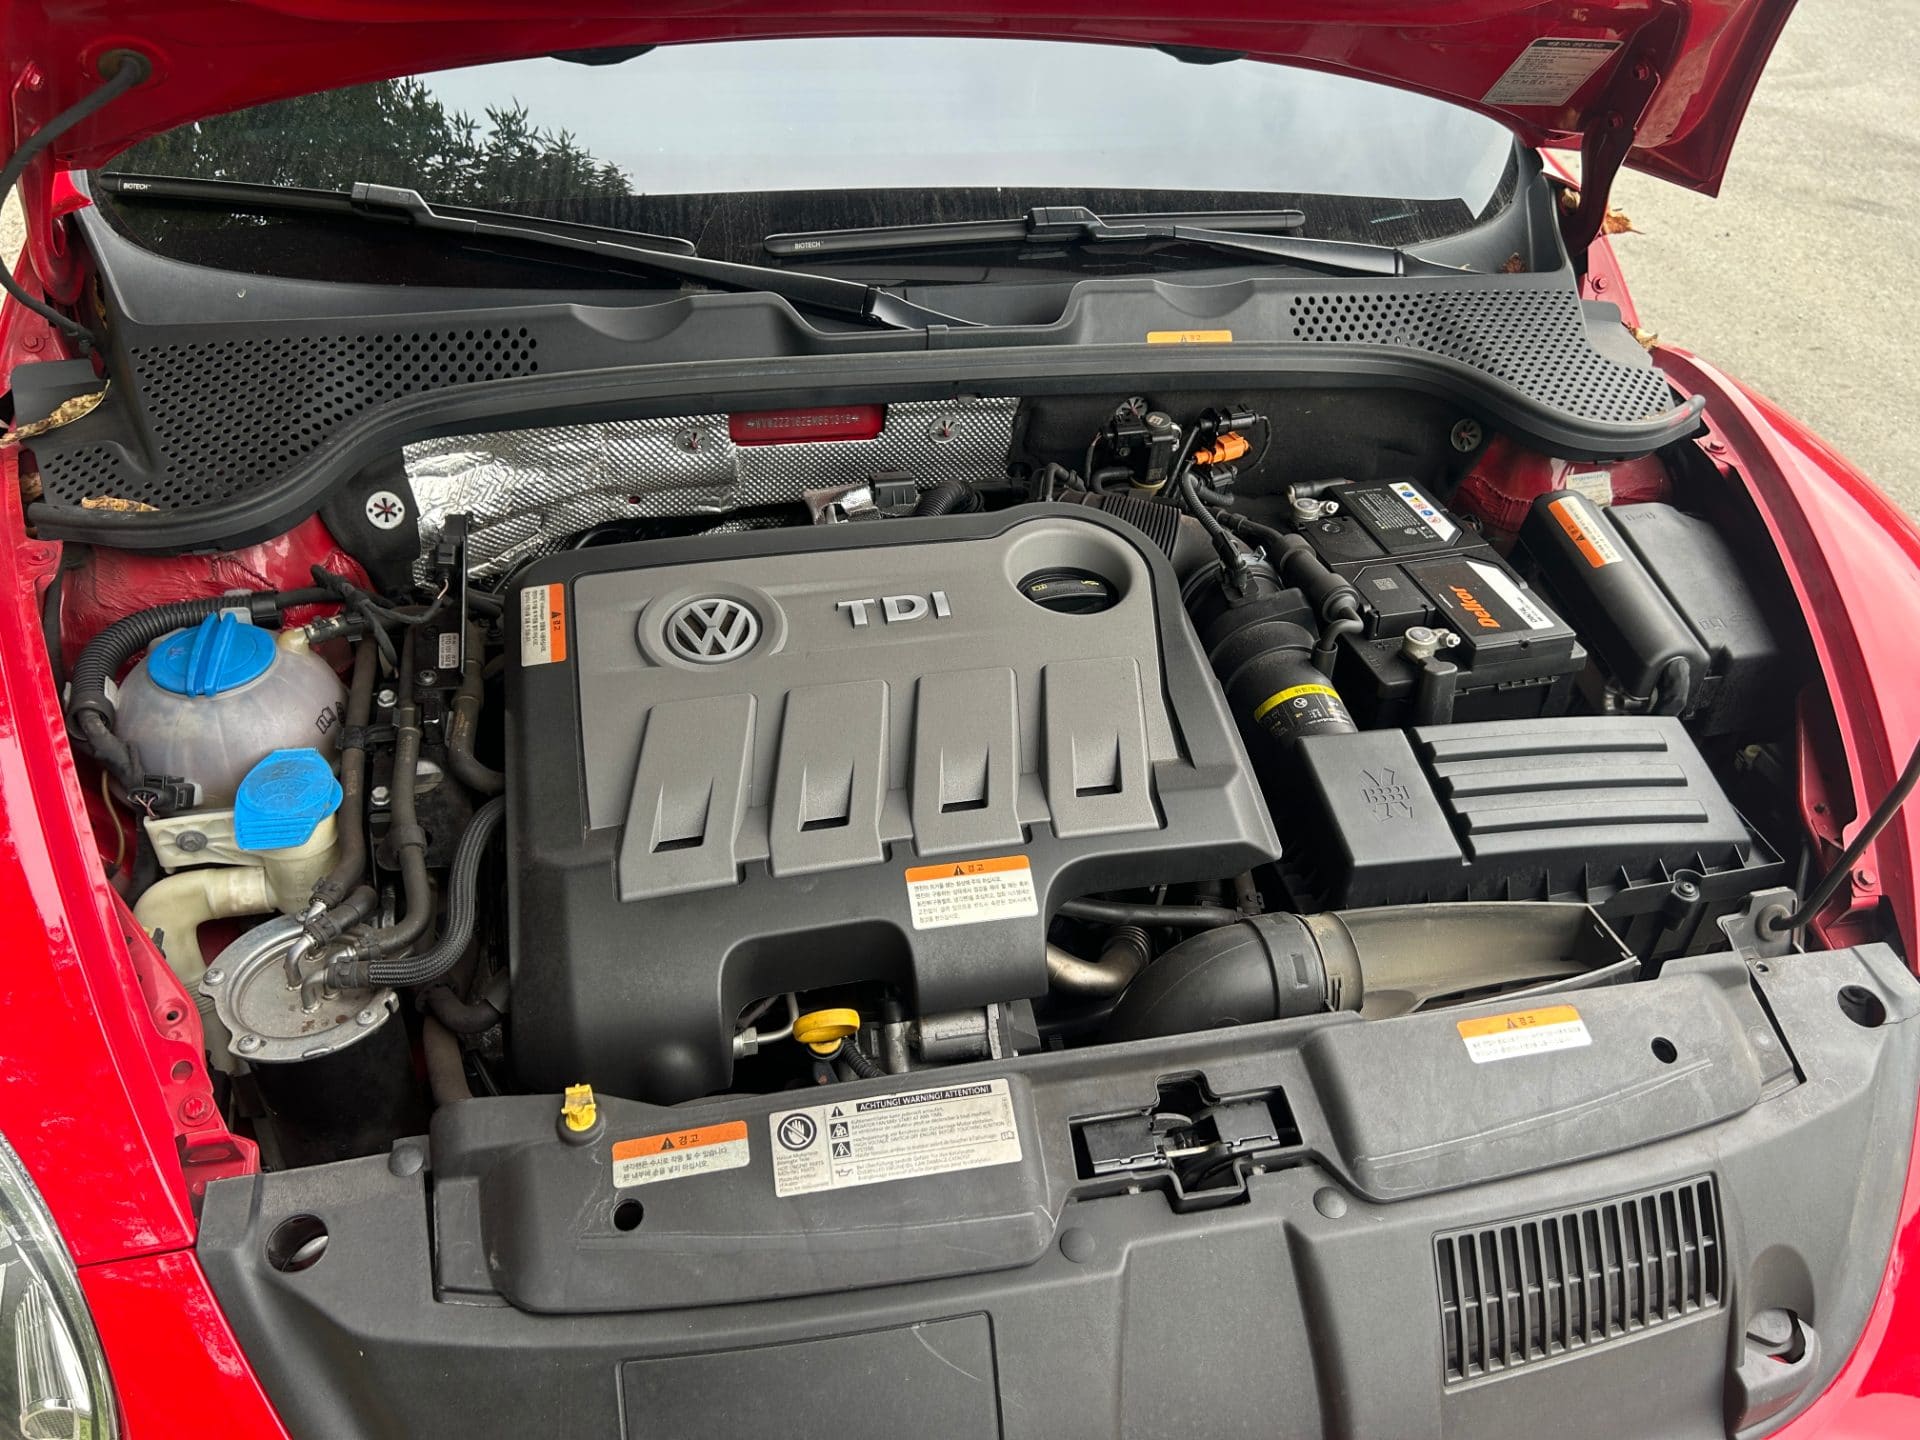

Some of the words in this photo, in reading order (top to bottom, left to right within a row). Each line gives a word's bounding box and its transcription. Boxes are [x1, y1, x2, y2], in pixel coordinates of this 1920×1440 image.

[836, 591, 951, 628] TDI
[1449, 585, 1501, 628] Delkor
[860, 1099, 900, 1111] ACHTUNG!
[903, 1092, 943, 1104] WARNING!
[945, 1085, 989, 1098] ATTENTION!
[678, 1133, 699, 1146] 경고
